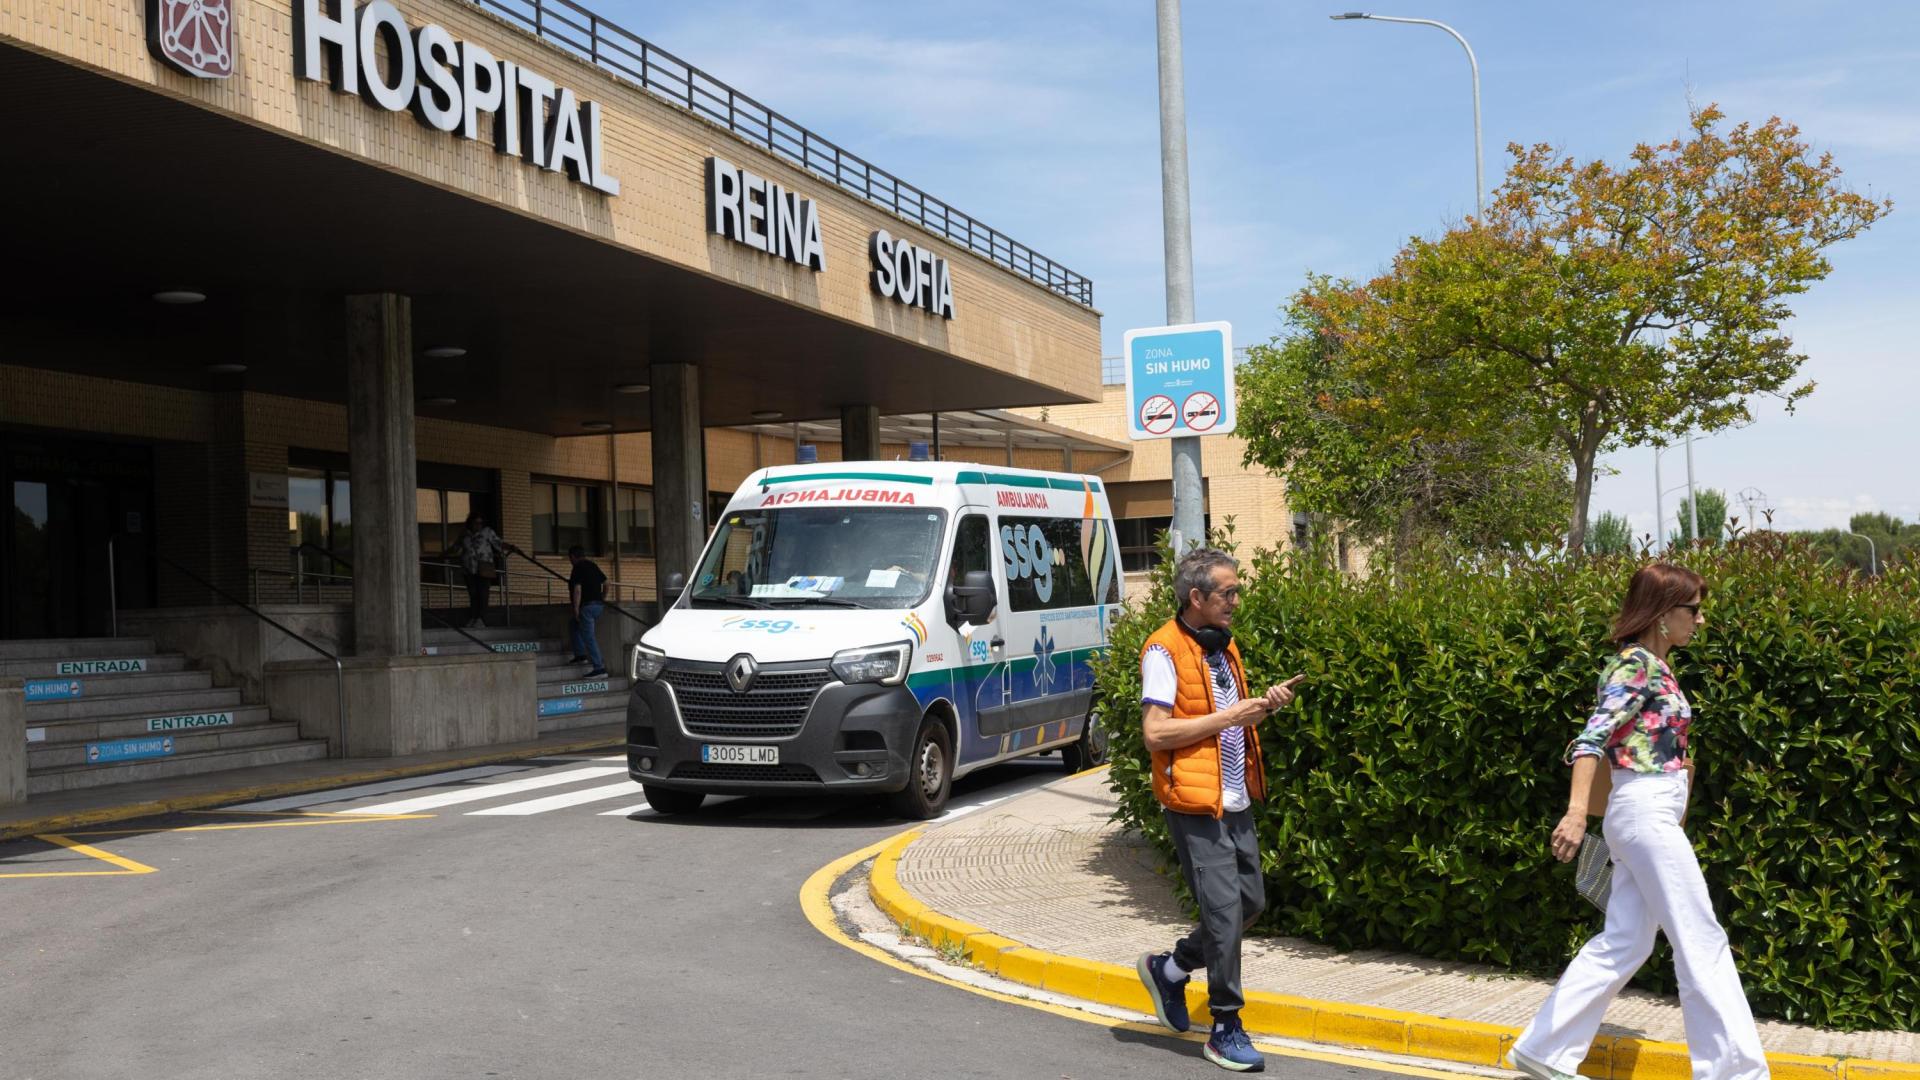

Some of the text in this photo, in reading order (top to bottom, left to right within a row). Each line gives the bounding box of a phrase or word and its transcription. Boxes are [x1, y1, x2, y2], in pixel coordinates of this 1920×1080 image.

[304, 0, 956, 320] HOSPITAL REINA SOFIA
[1145, 348, 1173, 360] ZONA
[1146, 358, 1211, 375] SIN HUMO
[997, 492, 1049, 509] AMBULANCIA
[1000, 524, 1053, 603] ssg
[740, 618, 794, 633] ssg
[493, 643, 538, 653] ENTRADA
[972, 641, 987, 662] ssg
[61, 660, 142, 674] ENTRADA
[29, 683, 69, 696] SIN HUMO
[564, 682, 607, 694] ENTRADA
[151, 713, 229, 731] ENTRADA
[100, 741, 162, 756] ZONA SIN HUMO
[712, 747, 776, 762] 3005 LMD
